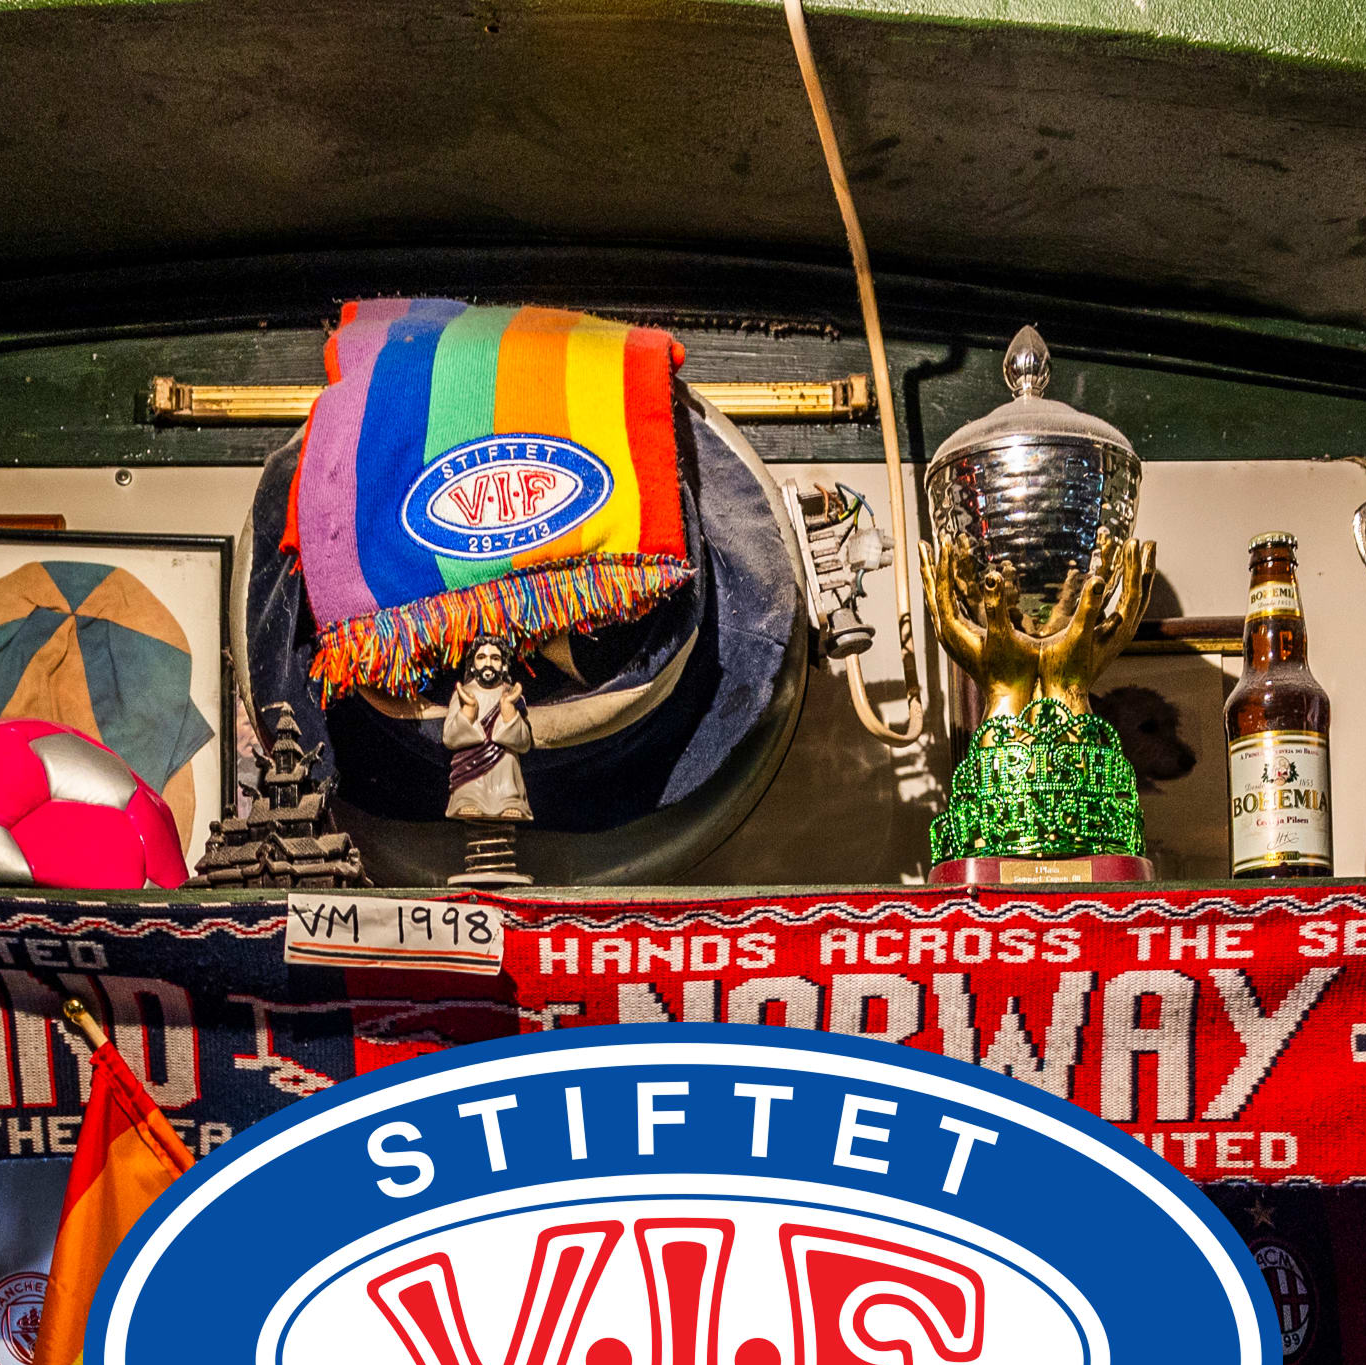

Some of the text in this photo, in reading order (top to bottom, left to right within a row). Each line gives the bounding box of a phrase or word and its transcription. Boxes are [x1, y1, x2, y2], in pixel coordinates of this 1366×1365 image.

[441, 445, 557, 479] STIFTET
[468, 522, 551, 553] 29-7-13
[979, 742, 1115, 794] IRISH
[292, 903, 493, 945] VM 1998
[539, 932, 777, 975] HANDS
[819, 927, 1082, 966] ACROSS
[1127, 922, 1255, 961] THE
[1132, 1131, 1299, 1169] ITED
